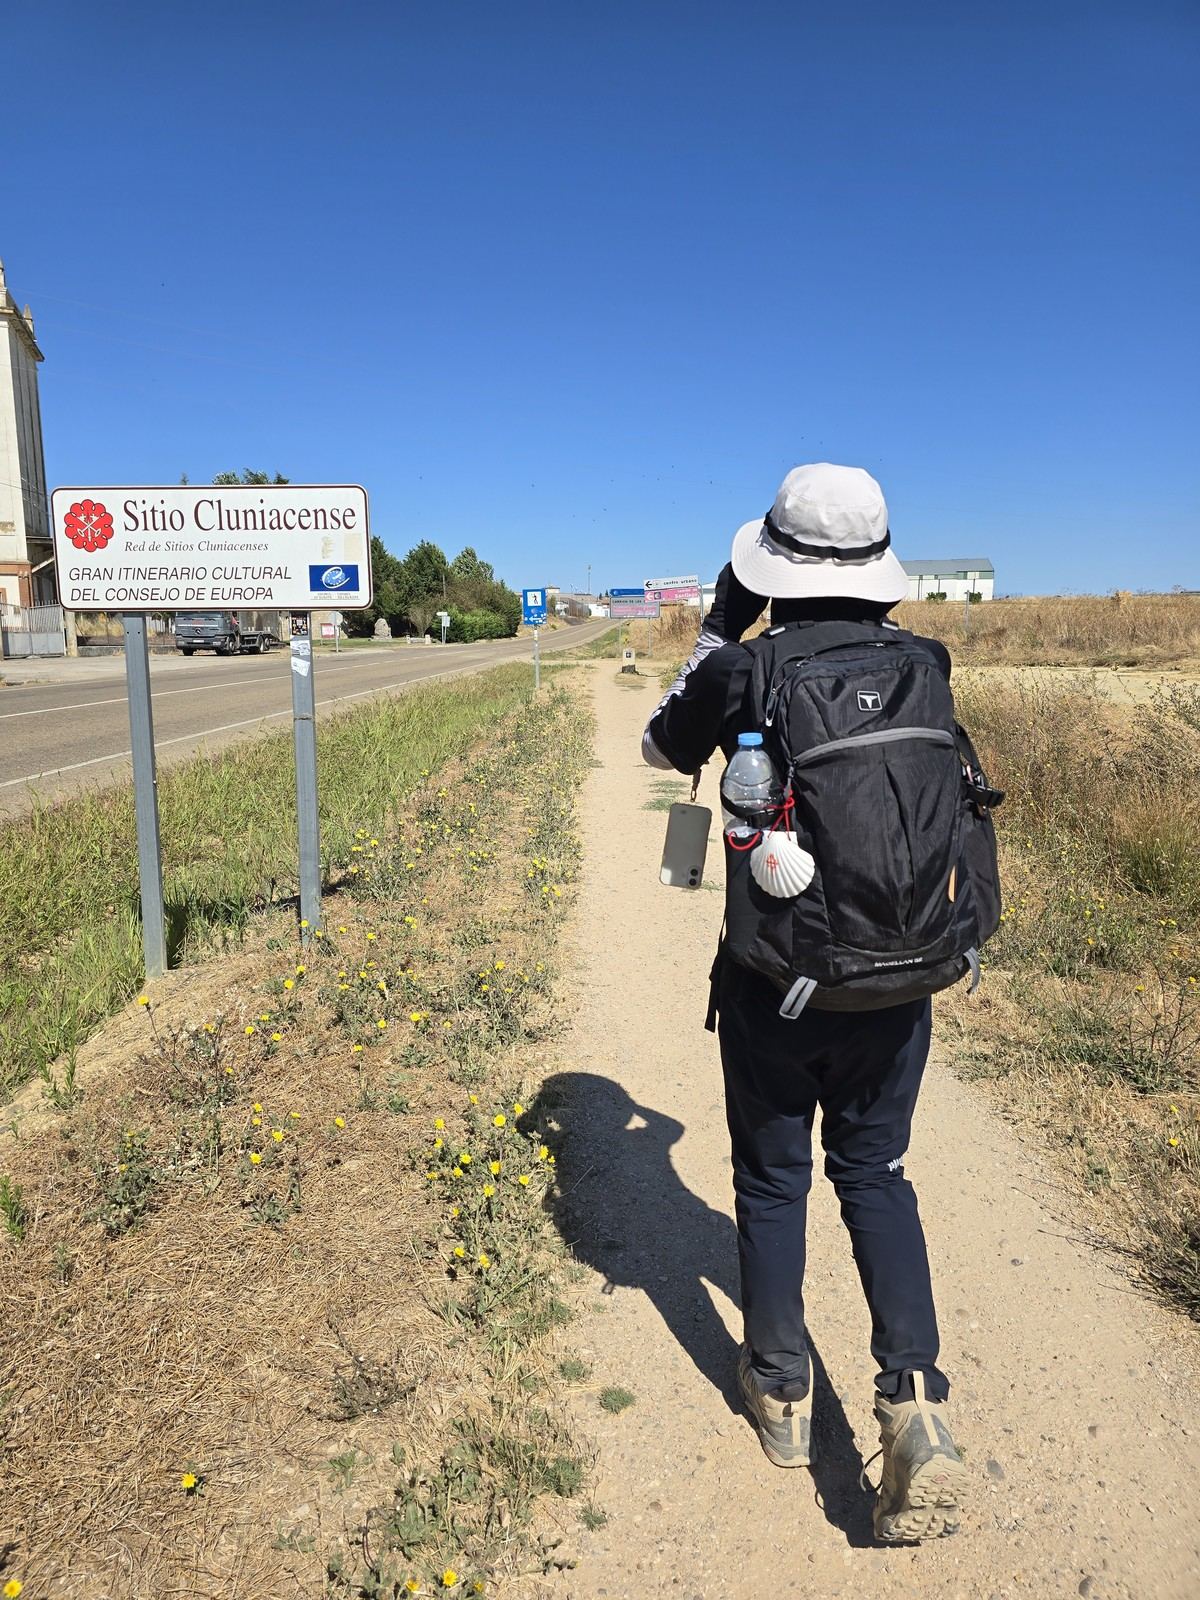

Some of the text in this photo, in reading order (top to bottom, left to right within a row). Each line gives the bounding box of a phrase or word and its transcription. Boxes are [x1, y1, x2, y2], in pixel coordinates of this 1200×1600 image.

[123, 498, 357, 532] Sitio Cluniacense
[124, 540, 269, 552] Red de Sitios Cluniacenses
[69, 566, 292, 581] GRAN ITINERARIO CULTURAL
[71, 587, 274, 602] DEL CONSEJO DE EUROPA
